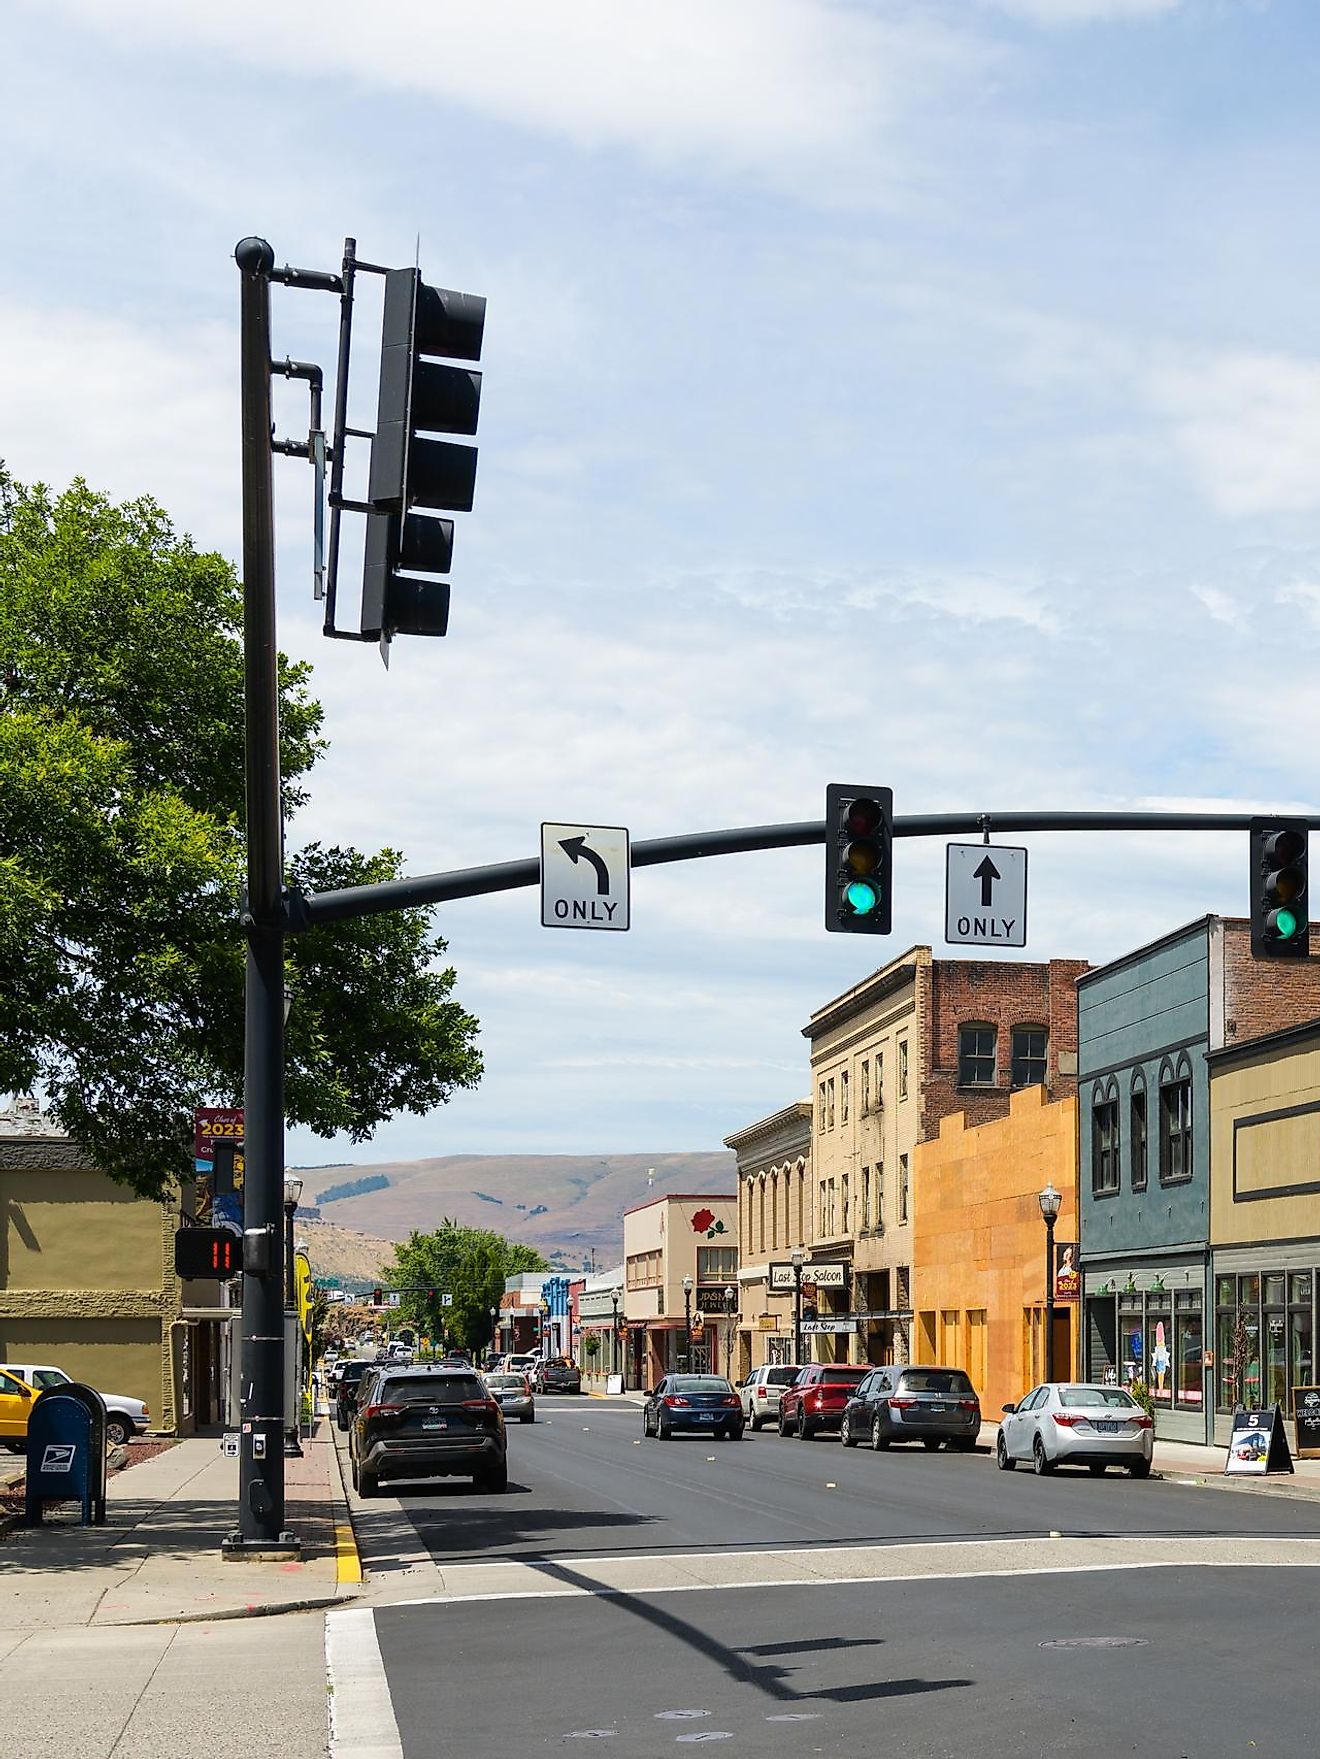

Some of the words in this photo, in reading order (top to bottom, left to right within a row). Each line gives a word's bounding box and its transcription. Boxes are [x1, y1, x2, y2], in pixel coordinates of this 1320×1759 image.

[554, 899, 618, 921] ONLY
[957, 916, 1015, 939] ONLY
[201, 1123, 245, 1136] 2023
[773, 1271, 790, 1283] Last
[813, 1270, 842, 1282] Saloon
[1248, 1414, 1259, 1427] 5
